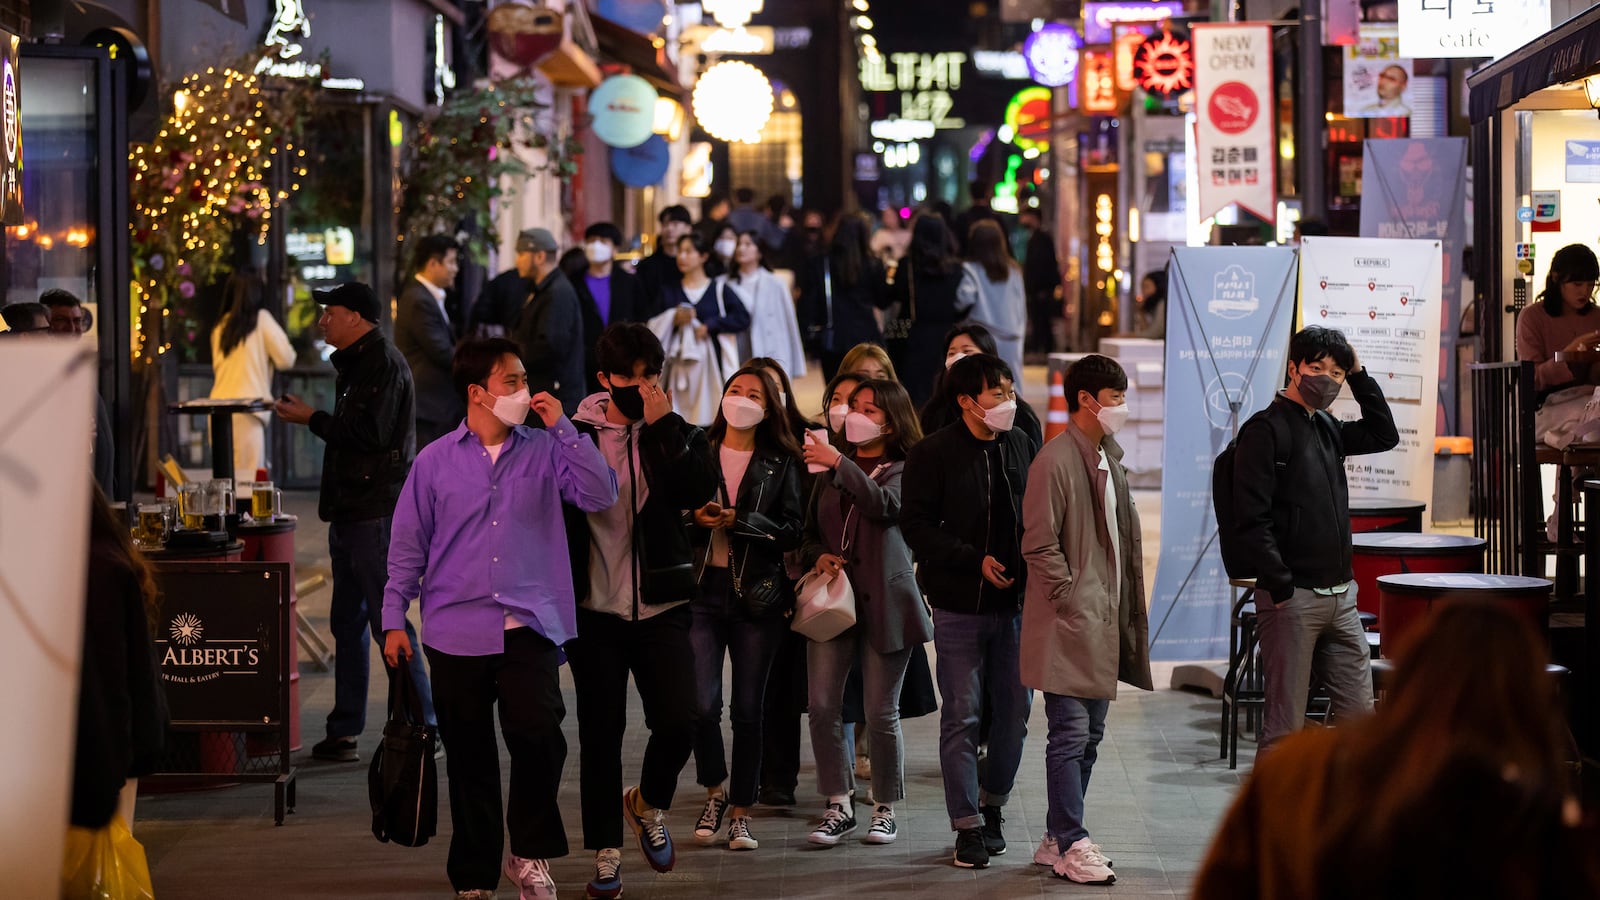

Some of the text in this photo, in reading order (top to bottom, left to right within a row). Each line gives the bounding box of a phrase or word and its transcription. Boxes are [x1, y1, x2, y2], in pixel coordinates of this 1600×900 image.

[1212, 35, 1251, 50] NEW
[1209, 53, 1256, 70] OPEN
[1343, 464, 1371, 475] 파스바
[161, 645, 259, 665] ALBERT'S
[171, 675, 188, 683] HALL
[197, 671, 220, 682] EATERY
